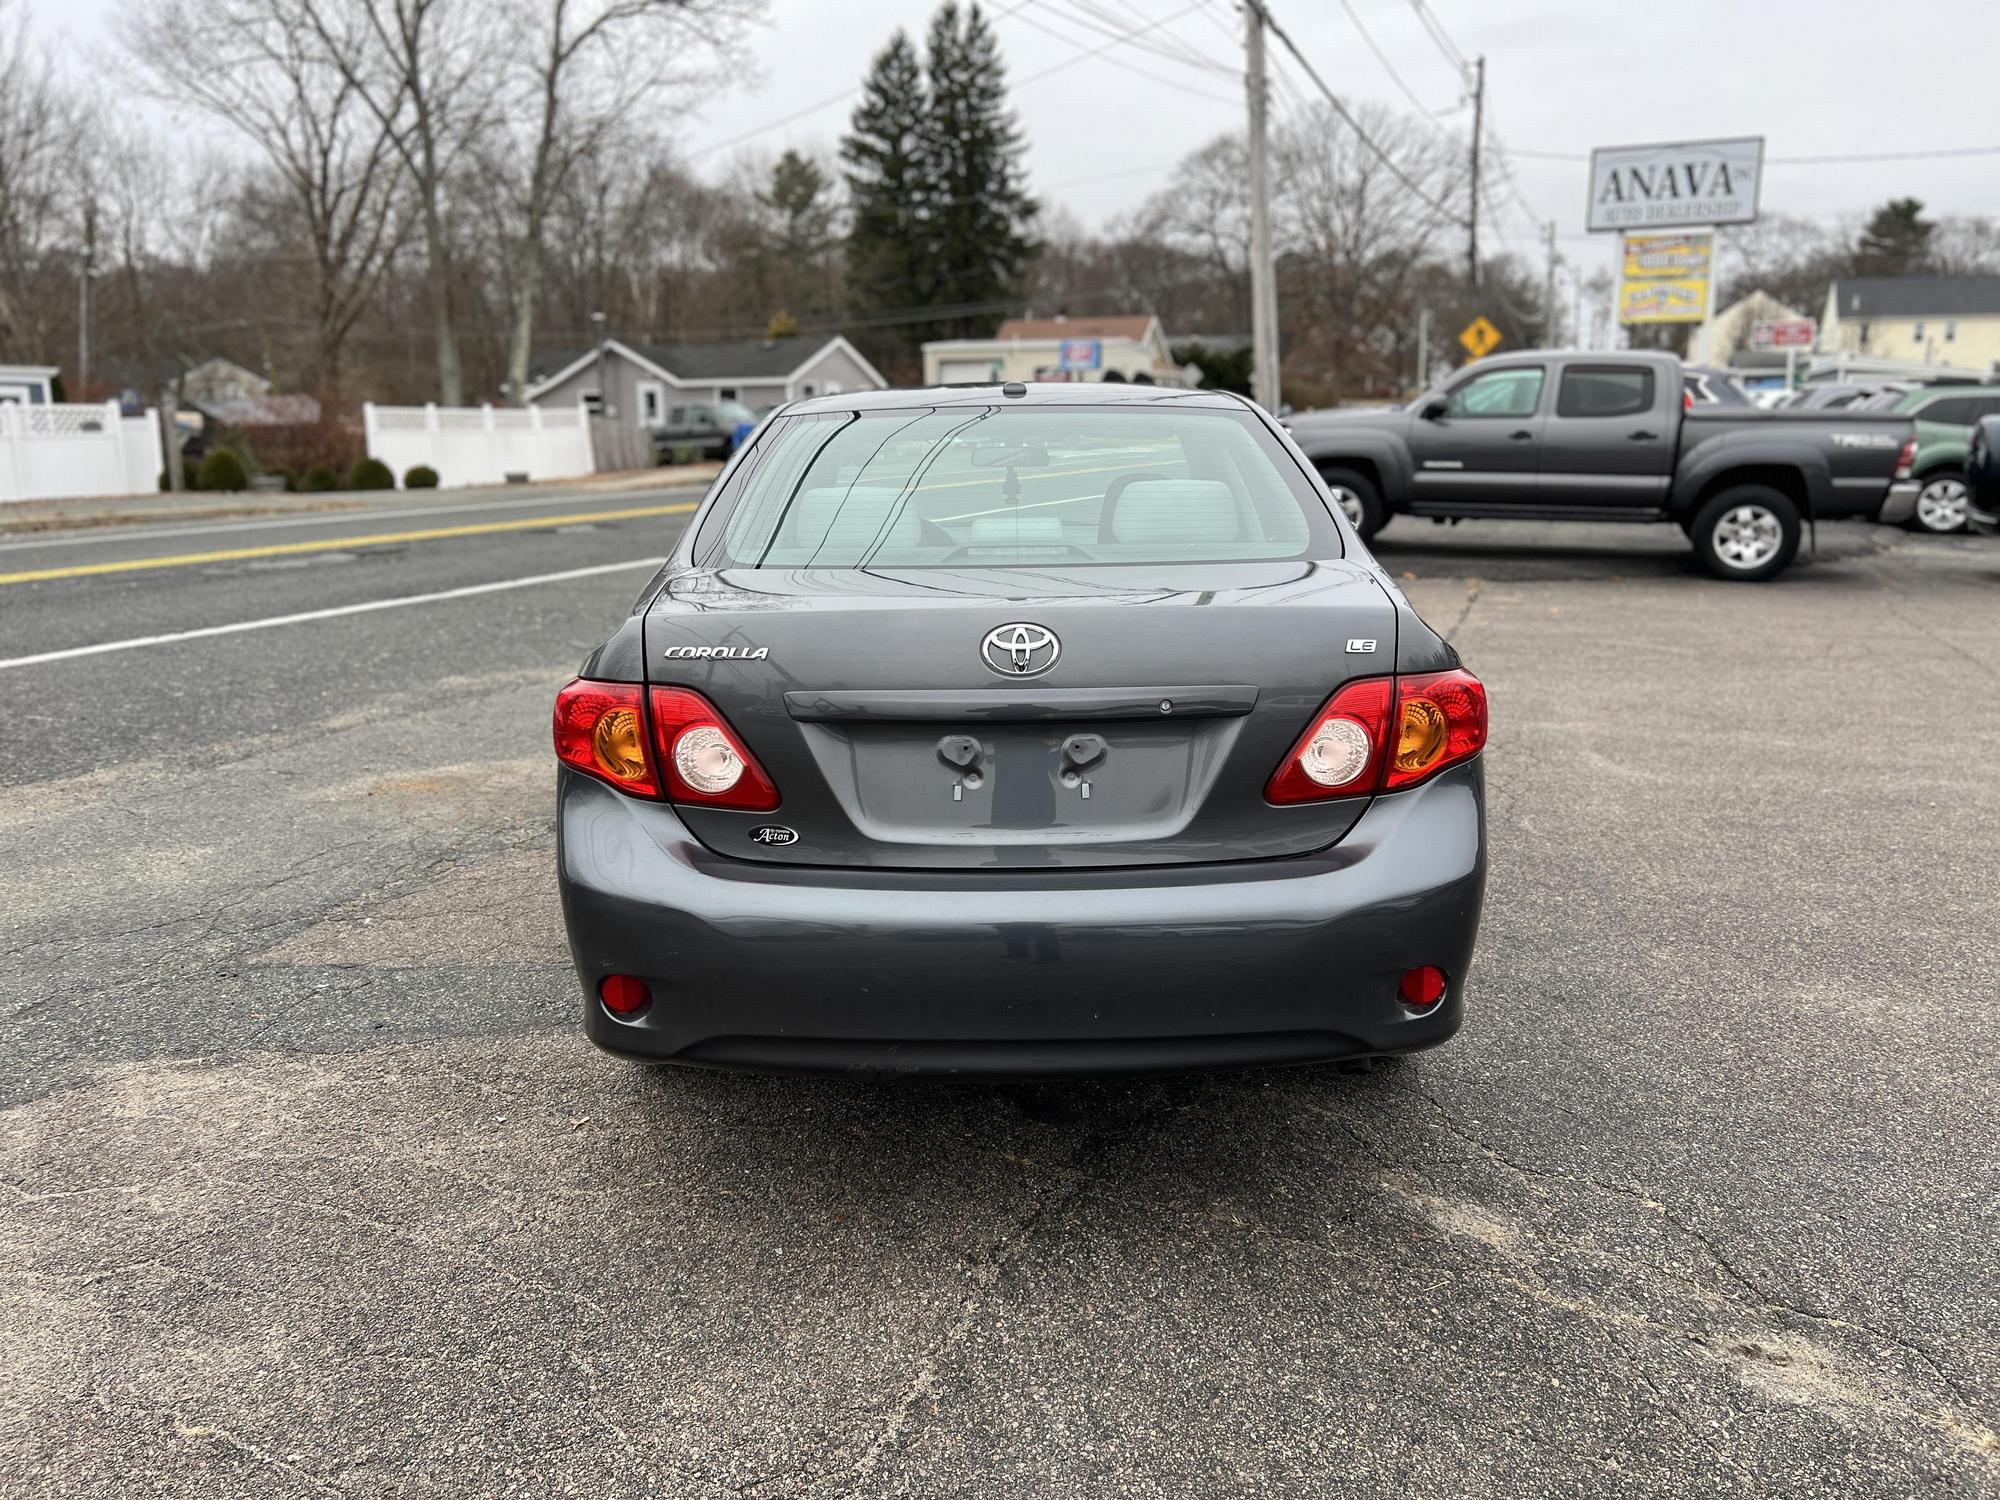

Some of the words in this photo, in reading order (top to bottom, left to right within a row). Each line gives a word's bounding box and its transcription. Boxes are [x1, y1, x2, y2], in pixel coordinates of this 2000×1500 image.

[1600, 161, 1734, 203] ANAVA
[1345, 639, 1377, 653] LE
[664, 646, 769, 661] COROLLA
[753, 828, 790, 842] Acton
